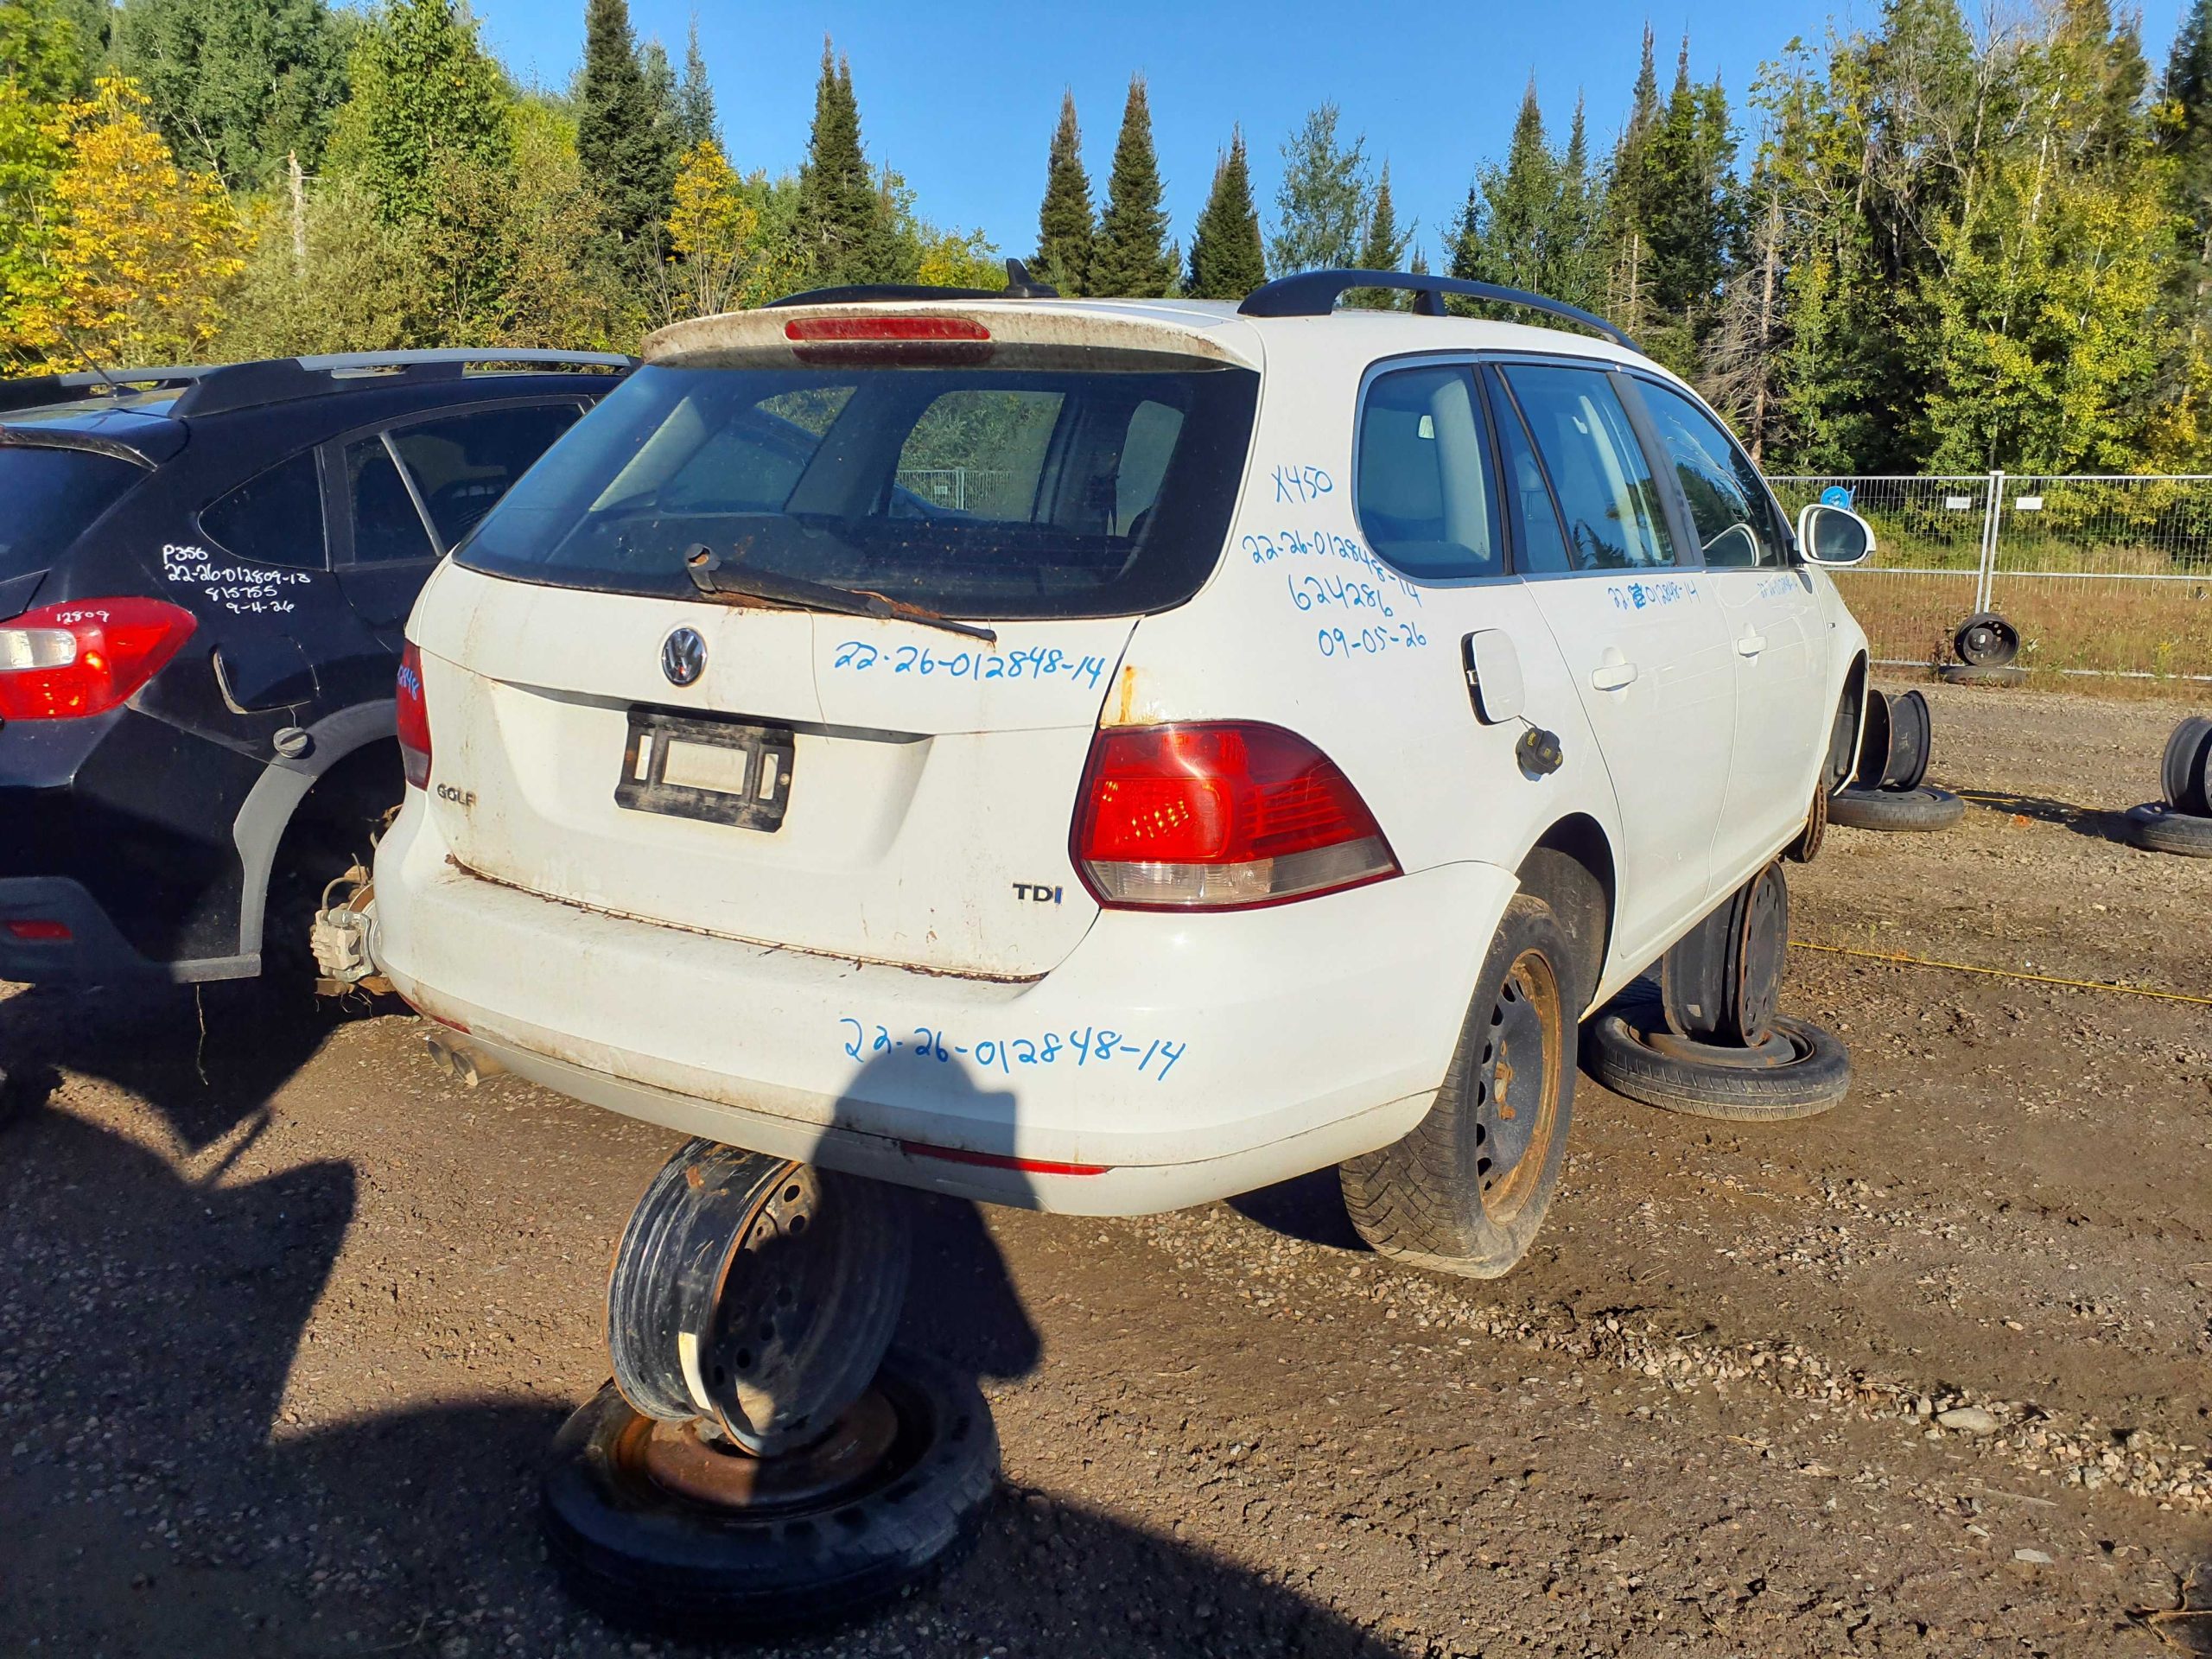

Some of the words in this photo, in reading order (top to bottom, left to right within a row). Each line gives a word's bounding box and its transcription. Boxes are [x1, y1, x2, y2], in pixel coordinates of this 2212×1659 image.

[1271, 464, 1333, 504] X450
[1287, 574, 1394, 617] 624286
[55, 610, 110, 625] 12809
[1318, 621, 1427, 658] 09-05-26
[436, 783, 477, 807] GOLF
[1012, 882, 1064, 905] TDI
[840, 1017, 1186, 1082] 22-26-012848-14
